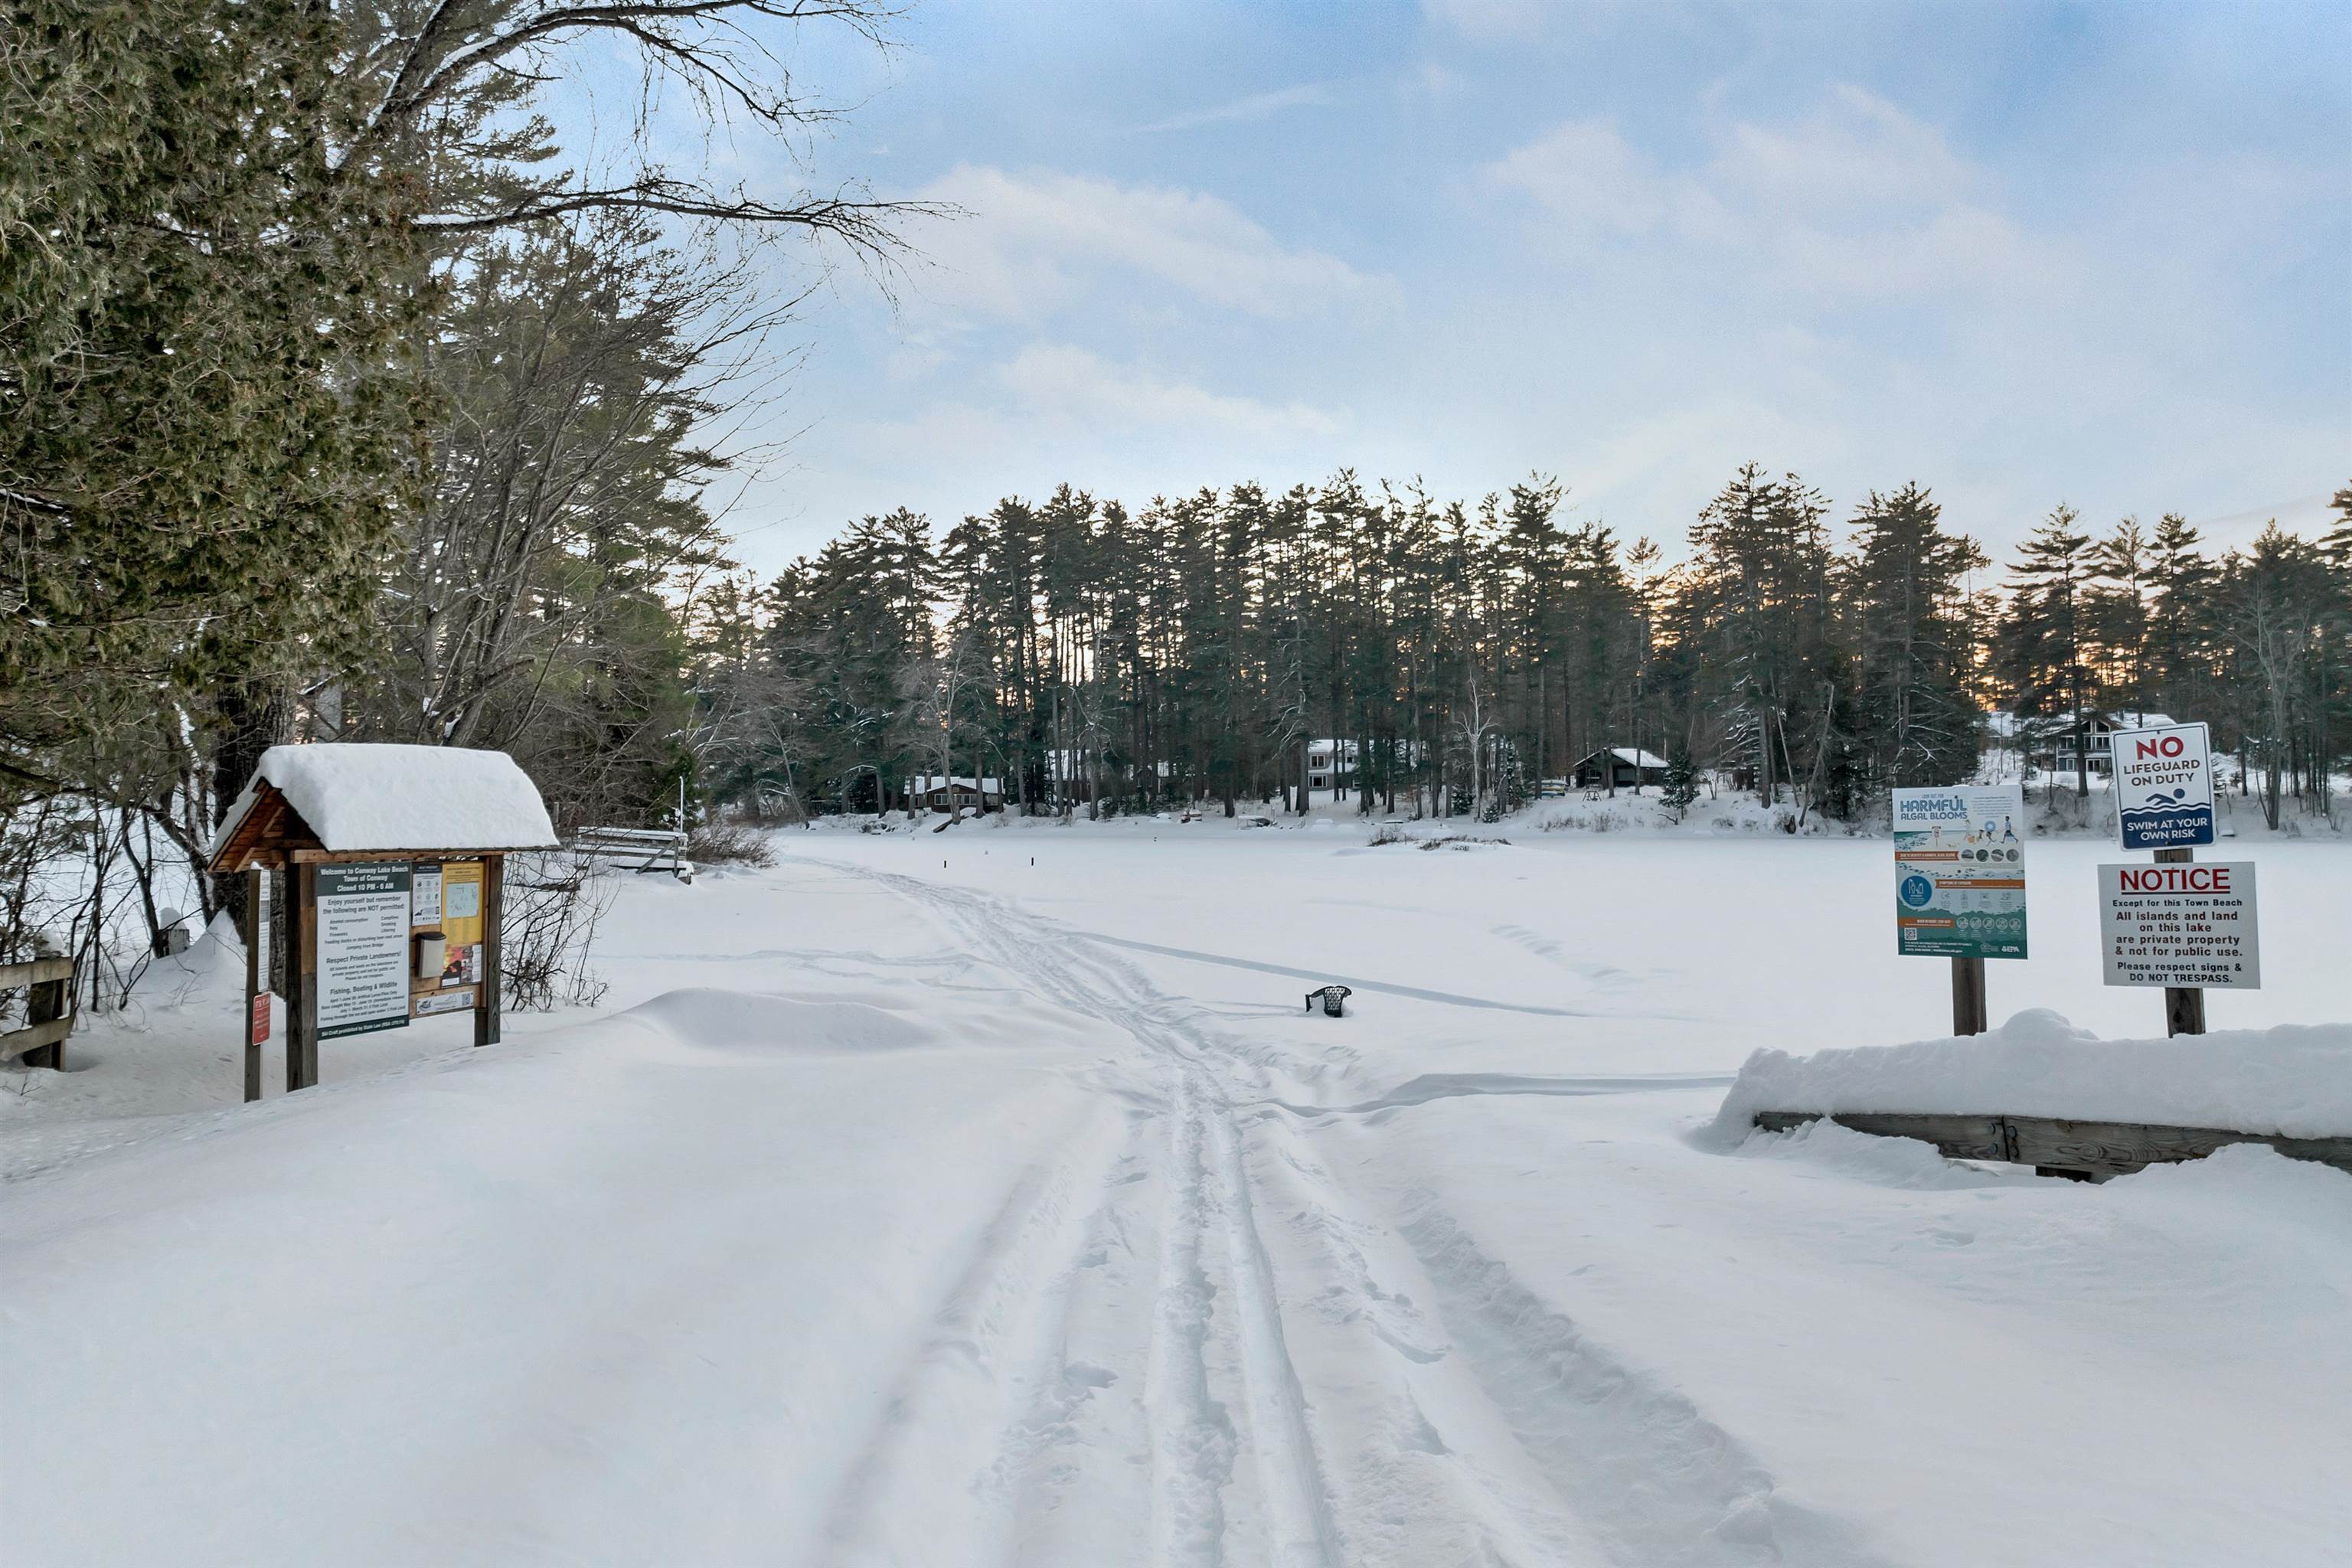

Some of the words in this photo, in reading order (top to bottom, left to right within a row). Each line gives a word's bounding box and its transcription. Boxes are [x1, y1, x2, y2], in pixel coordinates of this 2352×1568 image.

[2136, 737, 2184, 760] NO
[2124, 760, 2200, 774] LIFEGUARD
[2132, 776, 2151, 786] ON
[2156, 773, 2194, 784] DUTY
[1900, 799, 1967, 812] HARMFUL
[2127, 822, 2158, 831] SWIM
[2161, 820, 2174, 828] AT
[2177, 818, 2207, 827] YOUR
[2141, 831, 2169, 840] OWN
[2172, 829, 2196, 838] RISK
[2120, 868, 2230, 891] NOTICE
[2116, 912, 2131, 920] All
[2137, 912, 2178, 920] islands
[2184, 912, 2206, 920] and
[2212, 911, 2237, 920] land
[2159, 923, 2180, 932] this
[2187, 923, 2211, 932] lake
[2140, 935, 2180, 945] private
[2187, 936, 2239, 946] property
[2115, 946, 2122, 956] &
[2153, 947, 2169, 956] for
[2175, 947, 2211, 957] public
[2118, 962, 2151, 970] Please
[2200, 963, 2230, 972] signs
[2235, 963, 2242, 972] &
[2174, 974, 2233, 982] TRESPASS.
